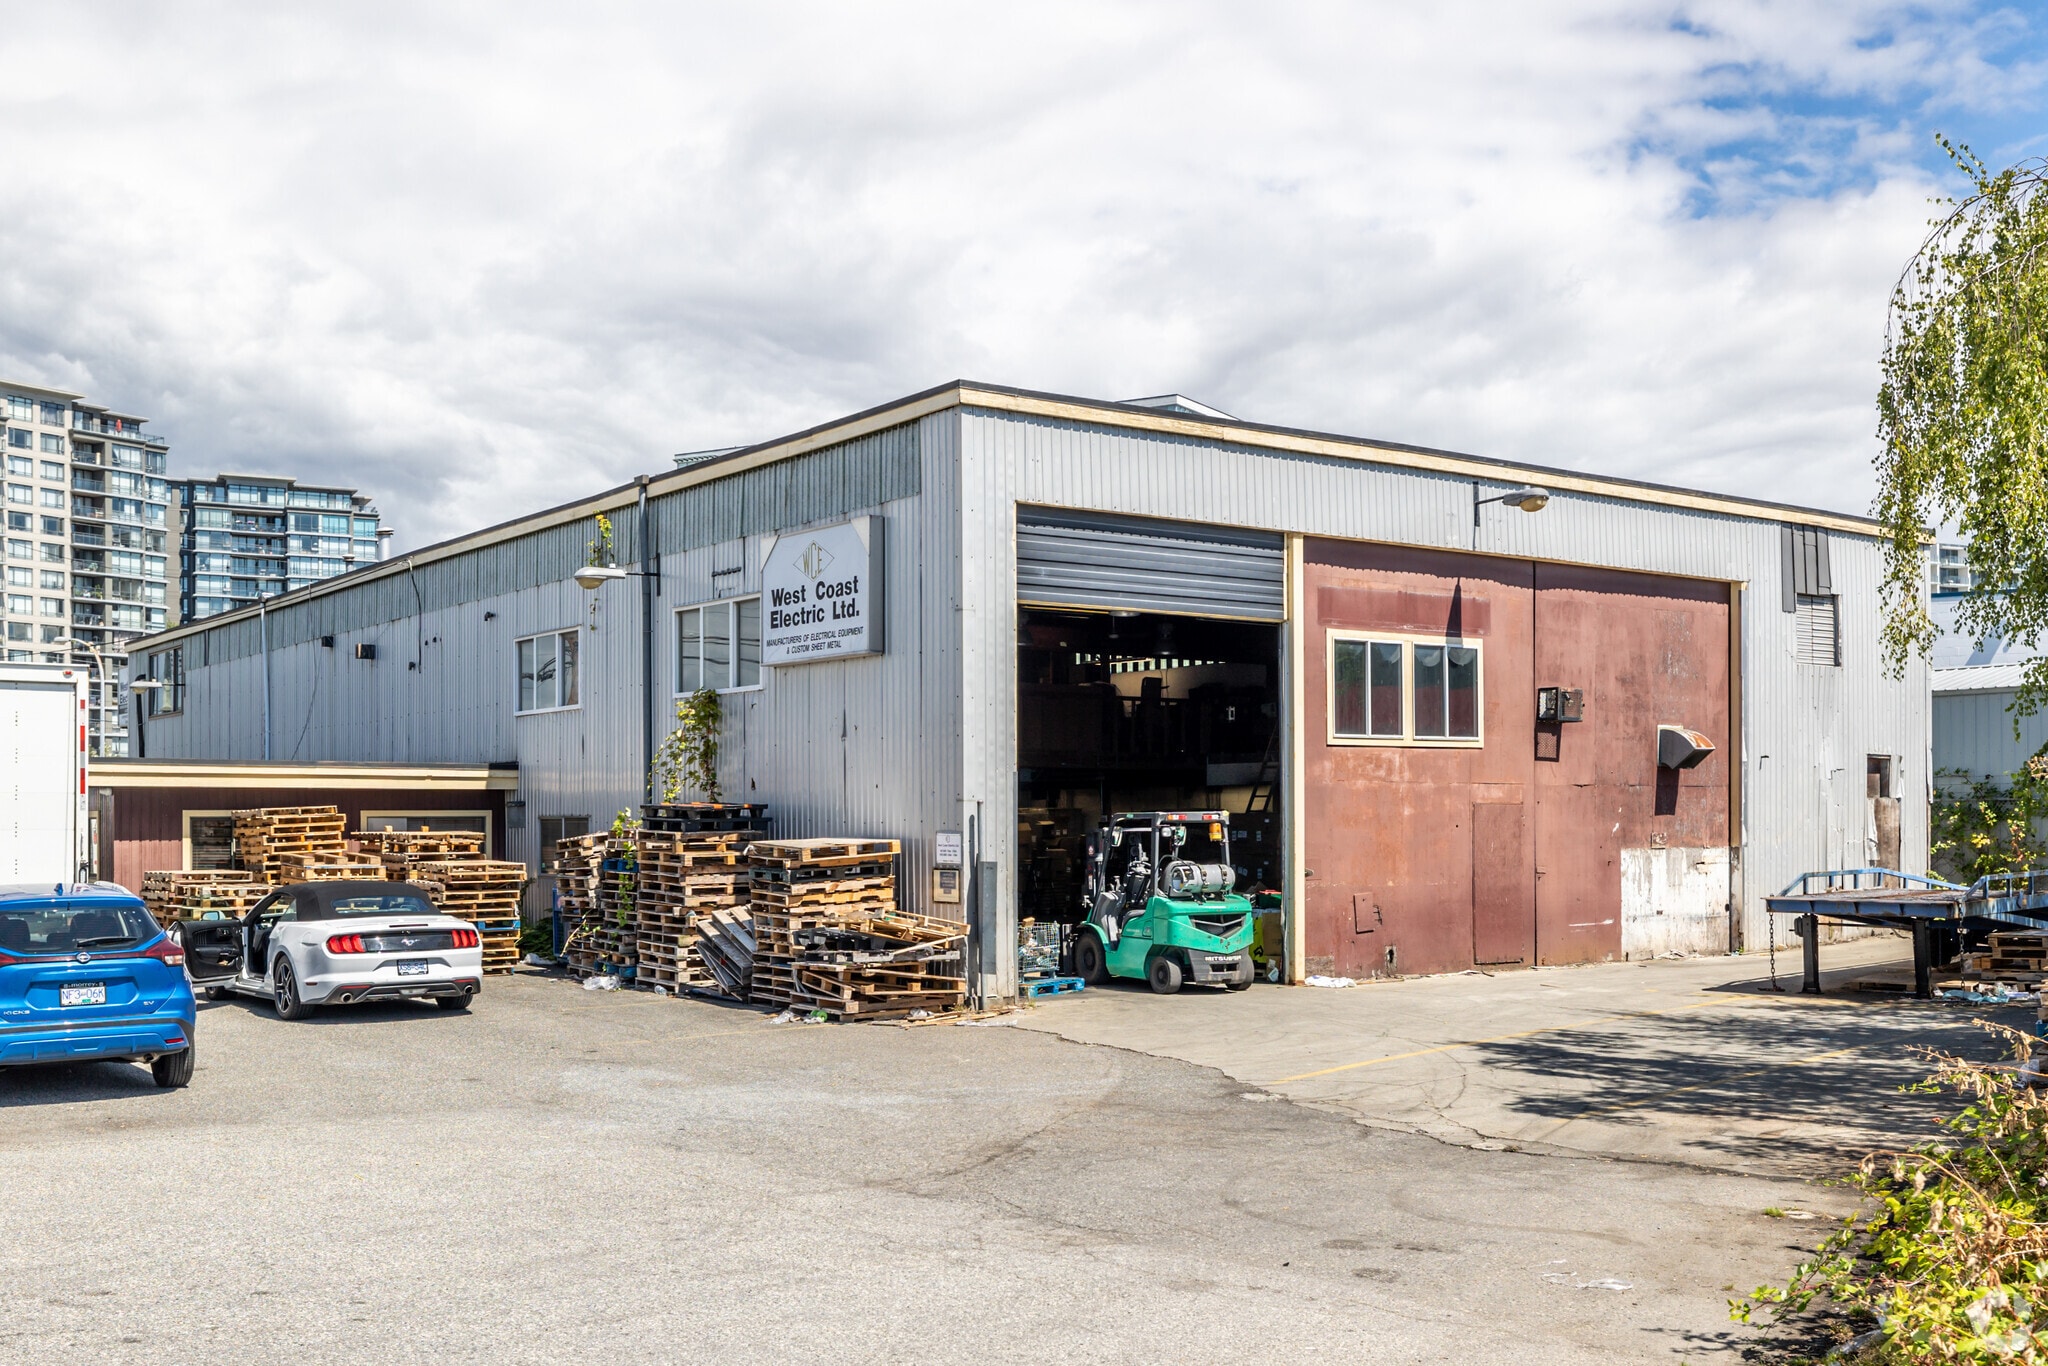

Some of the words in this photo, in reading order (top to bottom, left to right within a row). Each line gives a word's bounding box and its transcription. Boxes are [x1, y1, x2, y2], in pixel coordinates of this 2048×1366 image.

[771, 585, 806, 607] West
[816, 576, 858, 600] Coast
[770, 604, 825, 629] Electric
[833, 598, 860, 620] Ltd.
[766, 635, 802, 647] MANUFACTURERS
[803, 634, 810, 642] OF
[810, 630, 837, 641] ELECTRICAL
[838, 626, 864, 637] EQUIPMENT
[791, 644, 810, 654] CUSTOM
[811, 642, 826, 652] SHEET
[827, 640, 842, 649] METAL
